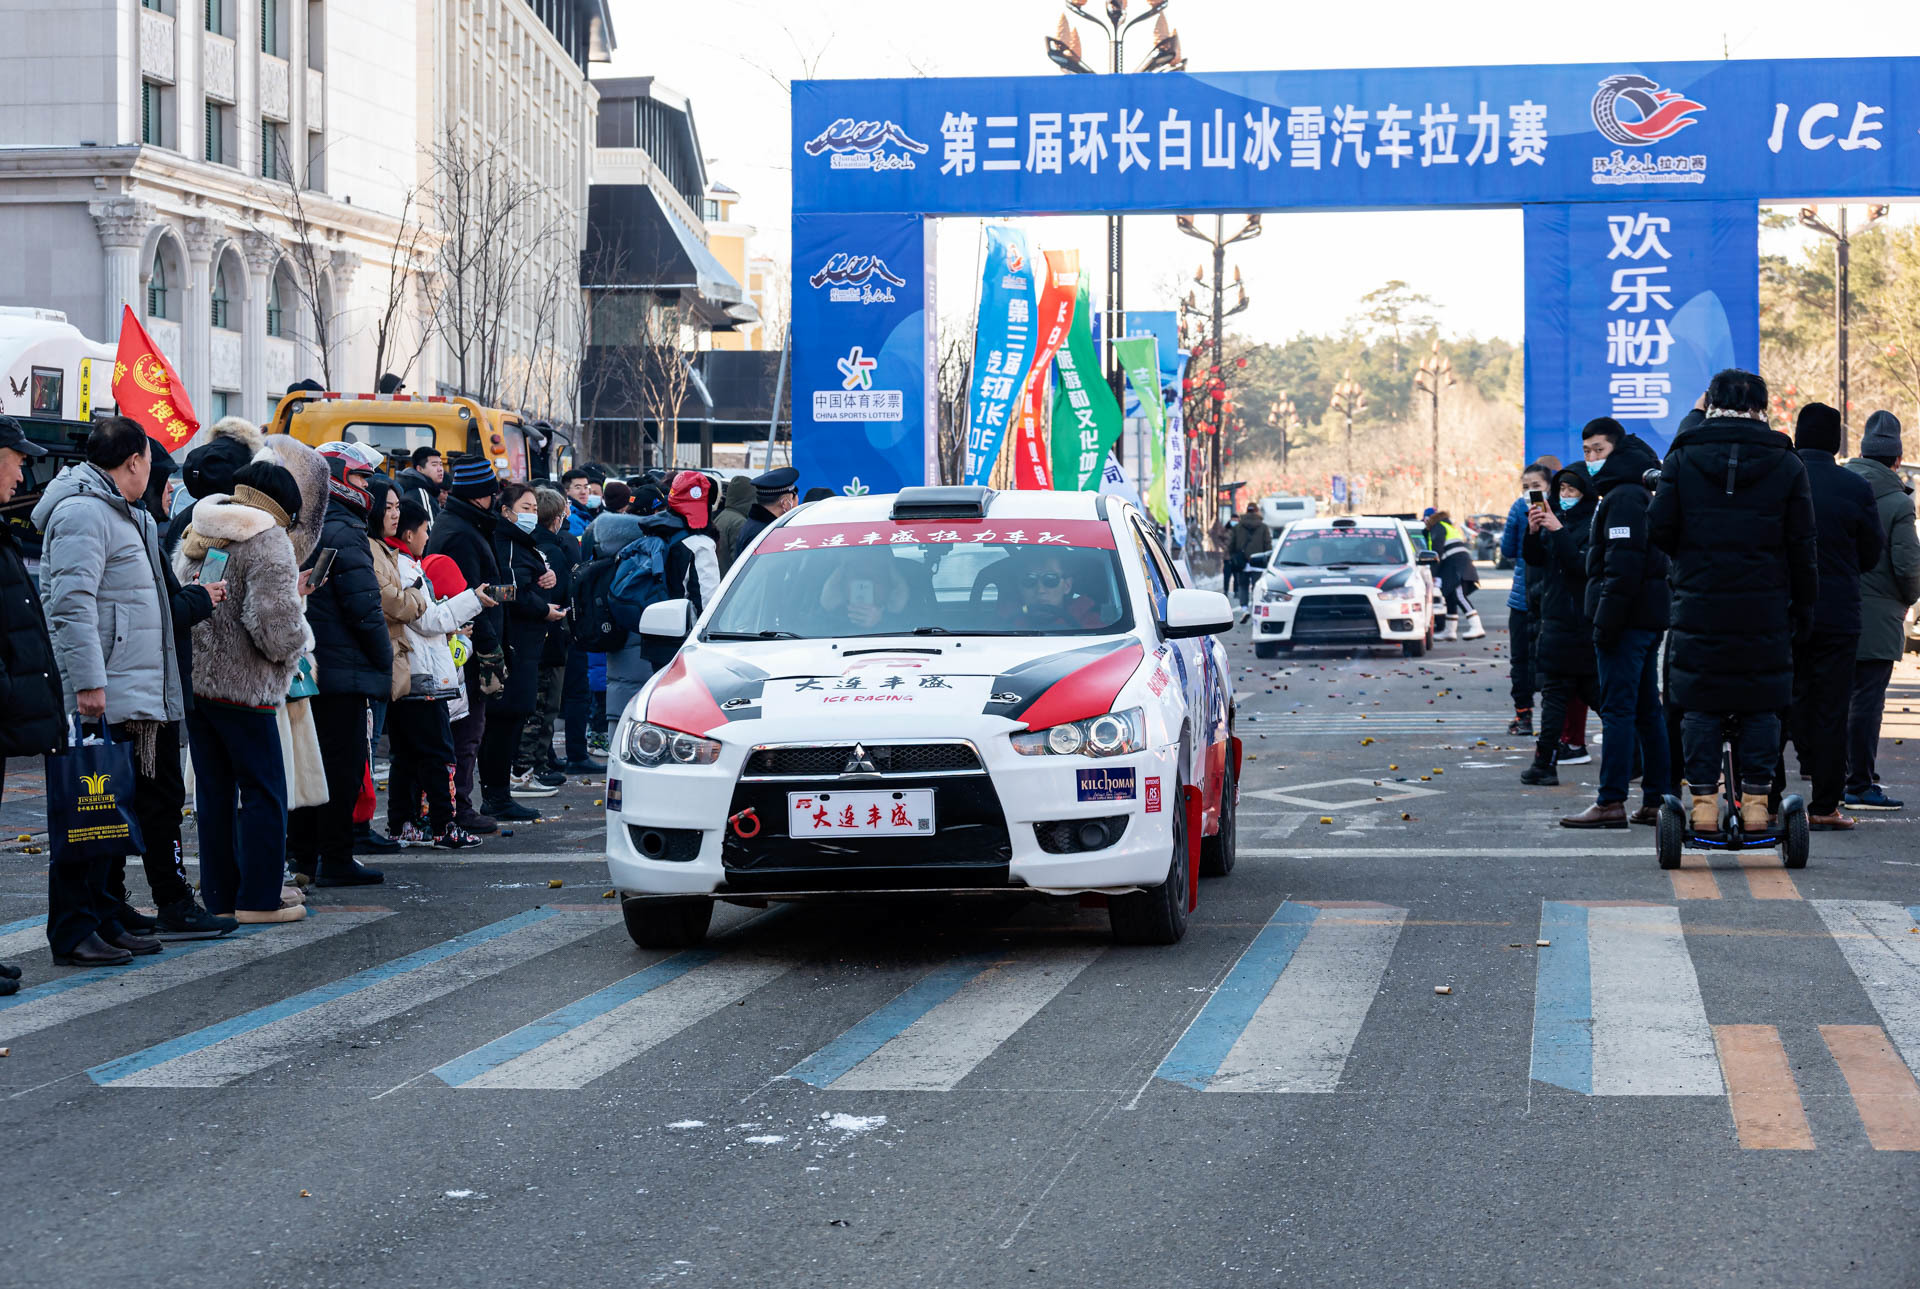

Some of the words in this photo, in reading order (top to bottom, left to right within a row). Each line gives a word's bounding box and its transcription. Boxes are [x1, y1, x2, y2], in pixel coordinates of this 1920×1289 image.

[939, 100, 1549, 177] 第三届环长白山冰雪汽车拉力赛
[1767, 101, 1885, 154] ICE
[1593, 150, 1706, 175] 环长白山拉力赛
[1606, 212, 1676, 419] 欢乐粉雪
[815, 393, 901, 409] 中国体育彩票
[147, 399, 189, 443] 搜救
[840, 411, 867, 419] SPORTS
[868, 411, 900, 419] LOTTERY
[784, 530, 1070, 551] 大连丰盛拉力车队
[795, 675, 953, 692] 大连丰盛
[854, 695, 913, 703] RACING
[1149, 787, 1157, 799] RS
[812, 803, 913, 829] 大连丰盛
[173, 840, 181, 864] FILA
